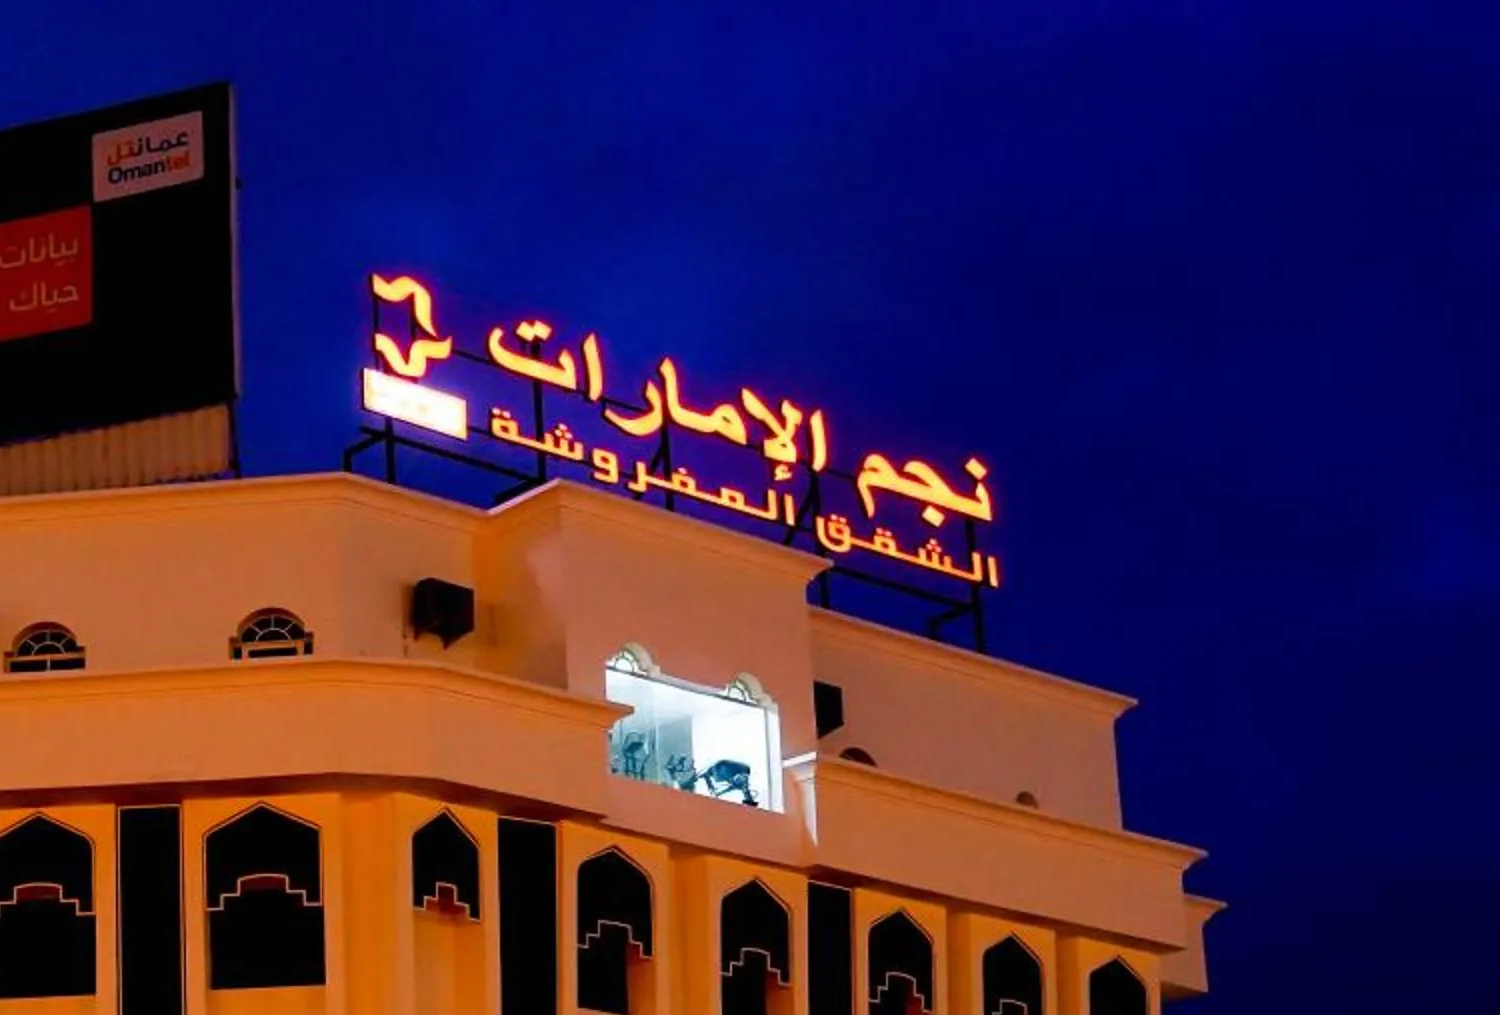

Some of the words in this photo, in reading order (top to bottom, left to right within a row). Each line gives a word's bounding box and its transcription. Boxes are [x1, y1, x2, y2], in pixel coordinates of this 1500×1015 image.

[107, 131, 189, 167] عمانتل
[107, 151, 190, 184] Omantel
[8, 281, 79, 314] حياك
[489, 320, 827, 482] الإمارات
[489, 408, 795, 526] المفروشة
[857, 450, 993, 528] نجم
[815, 513, 998, 588] الشقق
